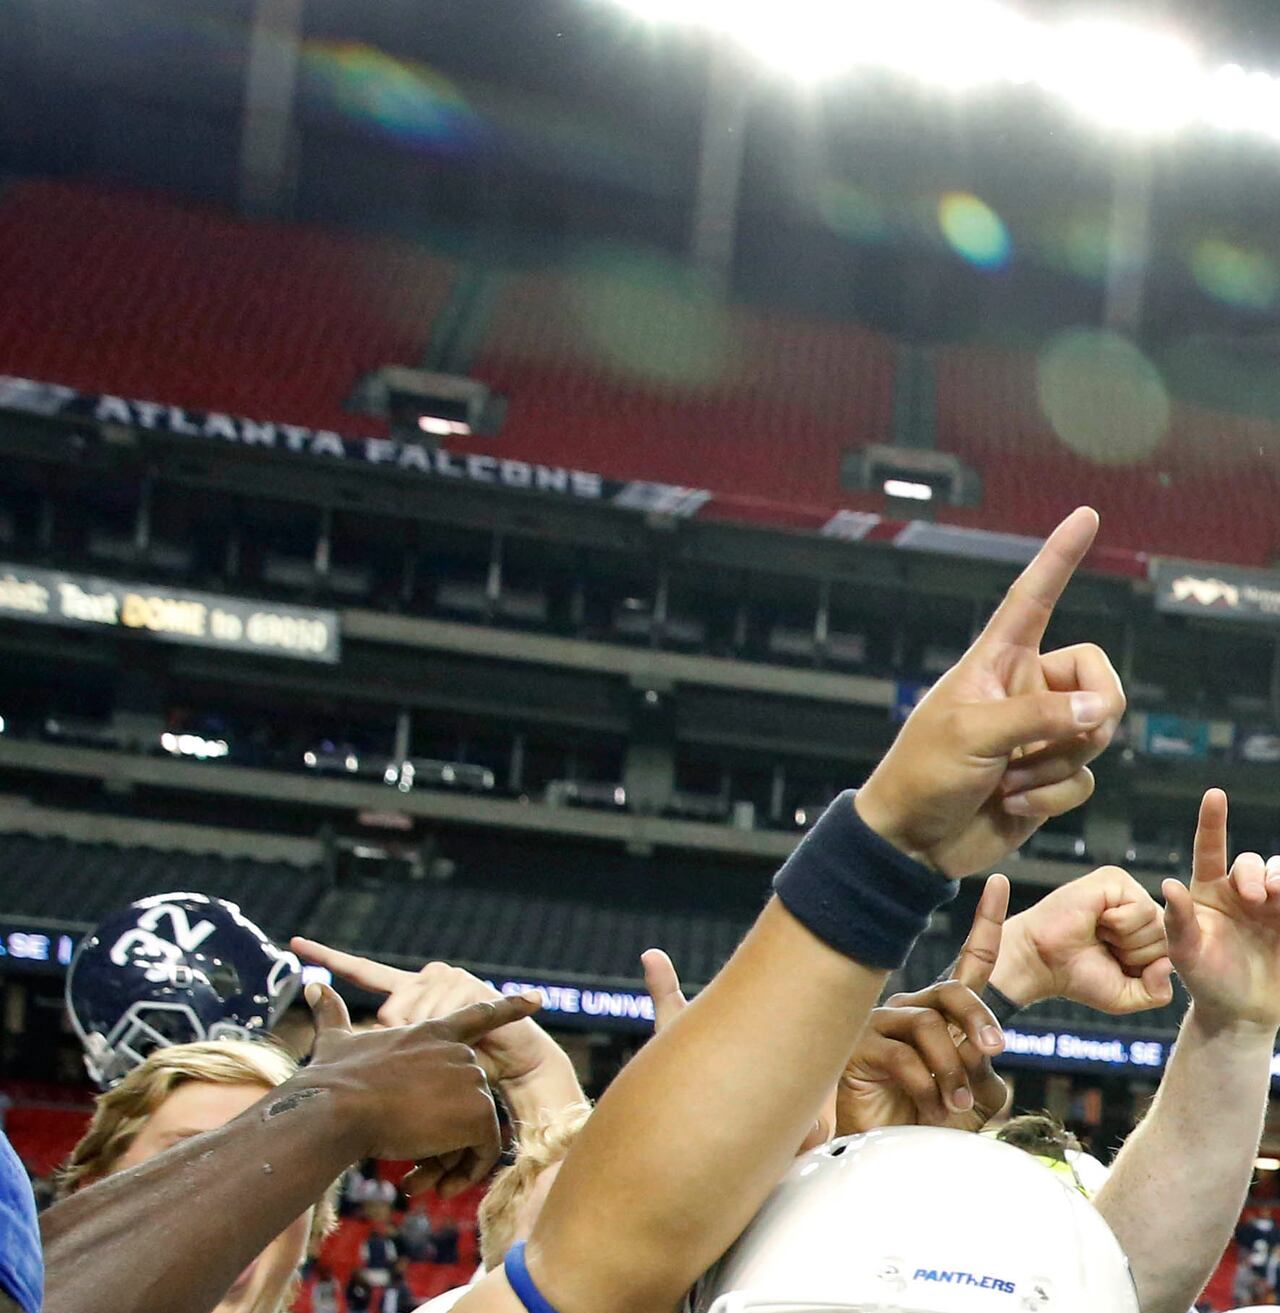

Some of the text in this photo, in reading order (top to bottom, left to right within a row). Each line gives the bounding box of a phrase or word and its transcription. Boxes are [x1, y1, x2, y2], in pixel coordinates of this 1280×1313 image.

[99, 394, 602, 498] ATLANTA FALCONS
[913, 1268, 1016, 1295] PANTHERS
